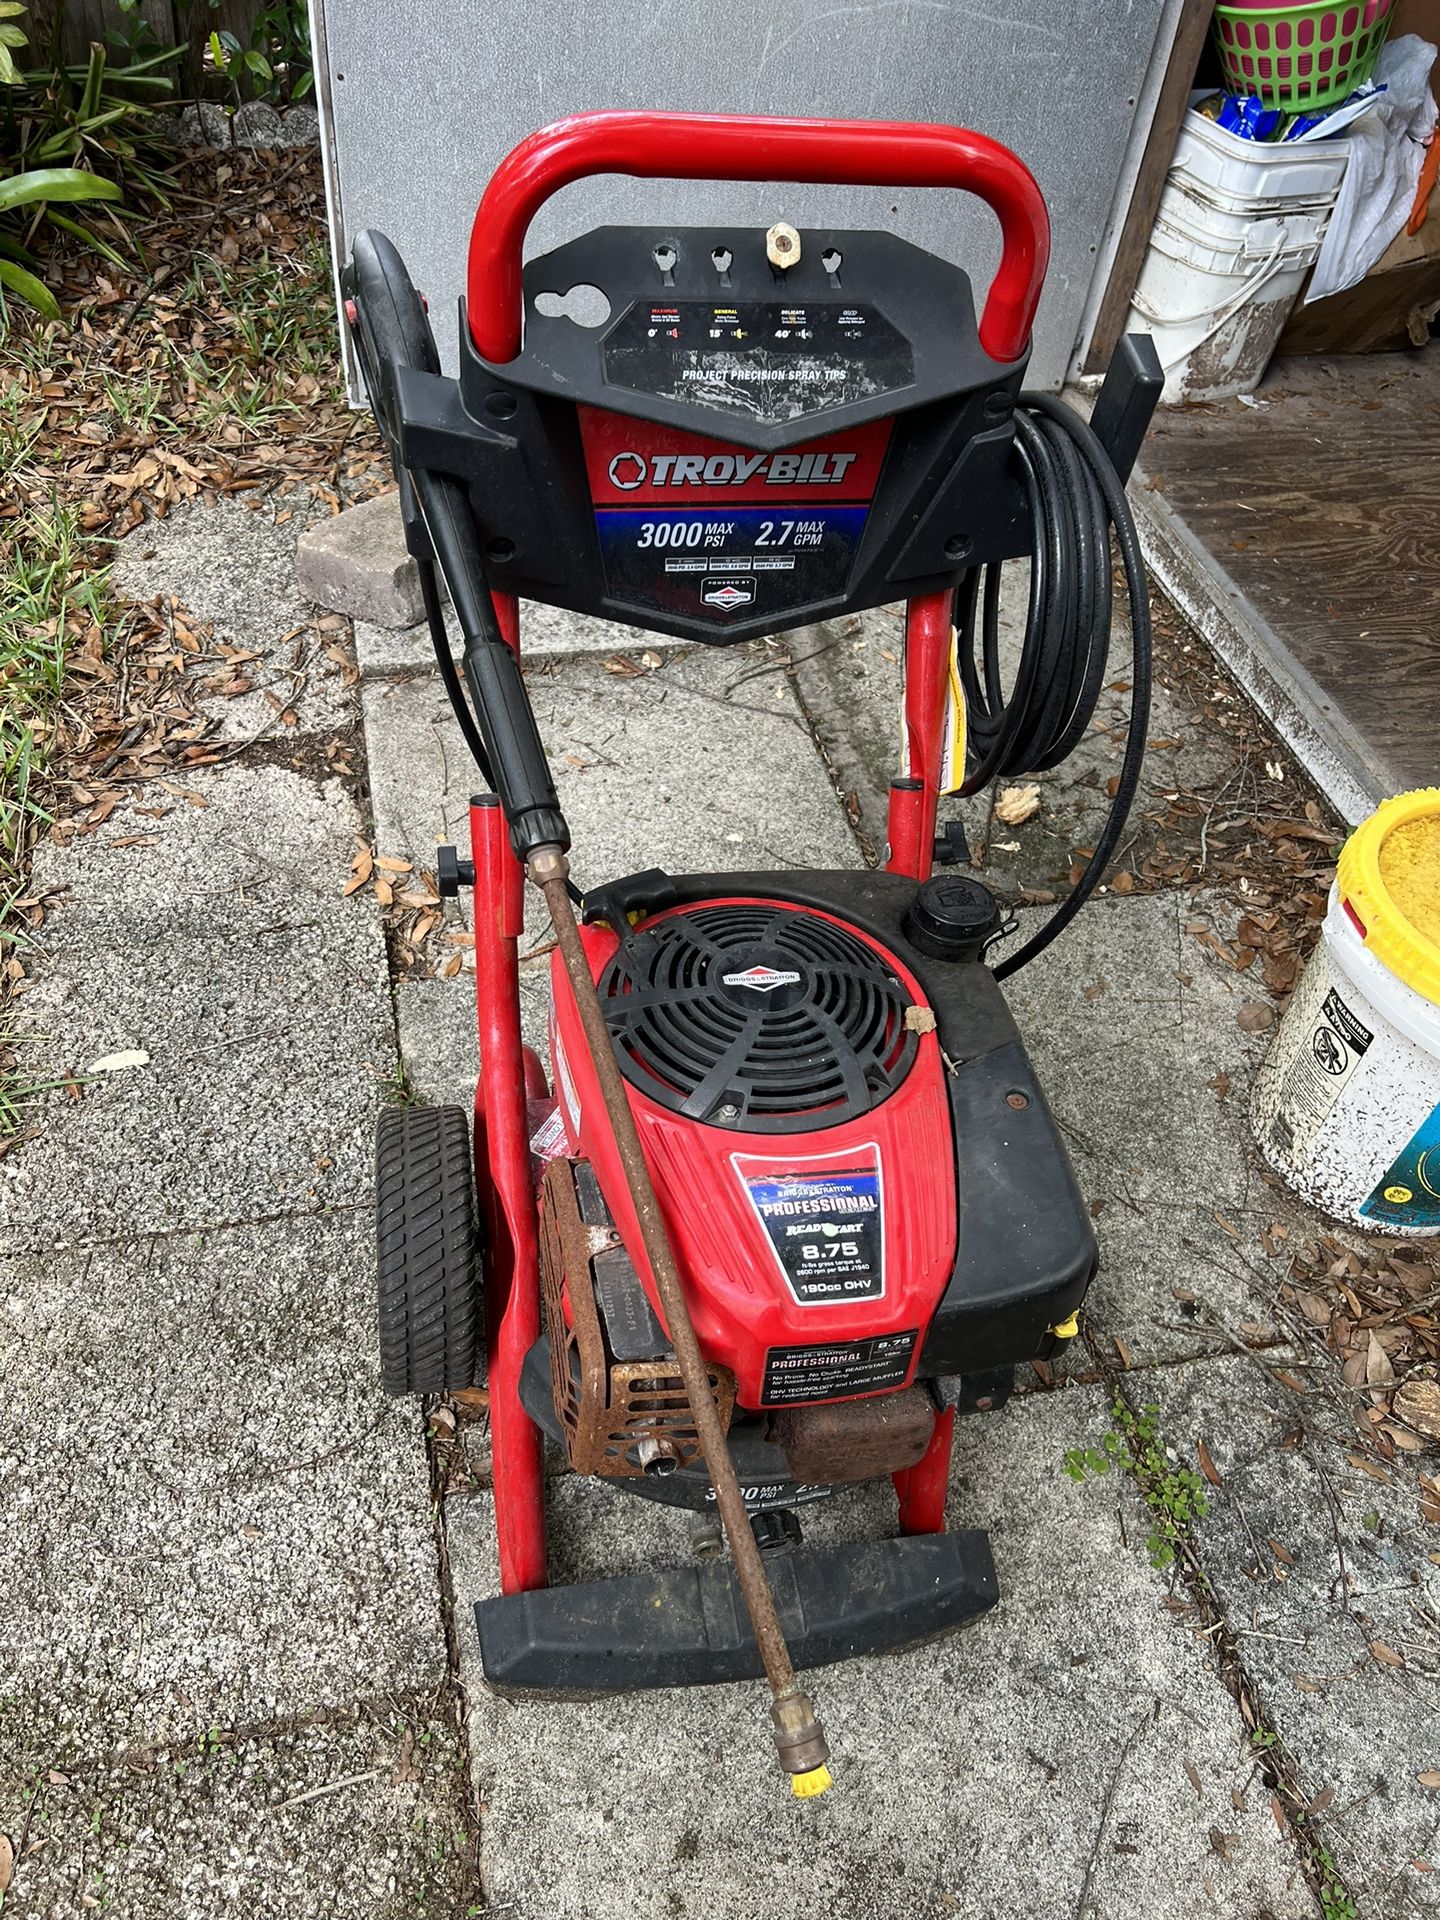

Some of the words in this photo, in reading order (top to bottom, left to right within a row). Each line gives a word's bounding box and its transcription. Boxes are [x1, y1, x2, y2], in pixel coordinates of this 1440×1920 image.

[682, 370, 728, 380] PROJECT
[731, 370, 785, 380] PRECISION
[788, 370, 821, 380] SPRAY
[824, 370, 847, 380] TIPS
[651, 453, 857, 486] TROY-BILT
[637, 522, 703, 548] 3000
[704, 523, 735, 535] MAX
[754, 521, 795, 546] 2.7
[796, 521, 826, 533] MAX
[793, 534, 823, 546] GPM
[704, 535, 726, 548] PSI
[1337, 1001, 1369, 1040] WARNING
[761, 1196, 878, 1217] PROFESSIONAL
[801, 1241, 859, 1260] 8.75
[835, 1259, 854, 1267] torque
[800, 1283, 842, 1294] 190cc
[844, 1279, 872, 1290] OHV
[878, 1337, 911, 1349] 8.75
[771, 1352, 862, 1369] PROFESSIONAL
[784, 1376, 821, 1385] hassle-free
[822, 1372, 850, 1382] starting
[787, 1383, 834, 1394] TECHNOLOGY
[849, 1377, 871, 1386] LARGE
[872, 1370, 904, 1382] MUFFLER
[781, 1391, 810, 1399] reduced
[759, 1491, 777, 1500] PSI
[760, 1484, 785, 1493] MAX
